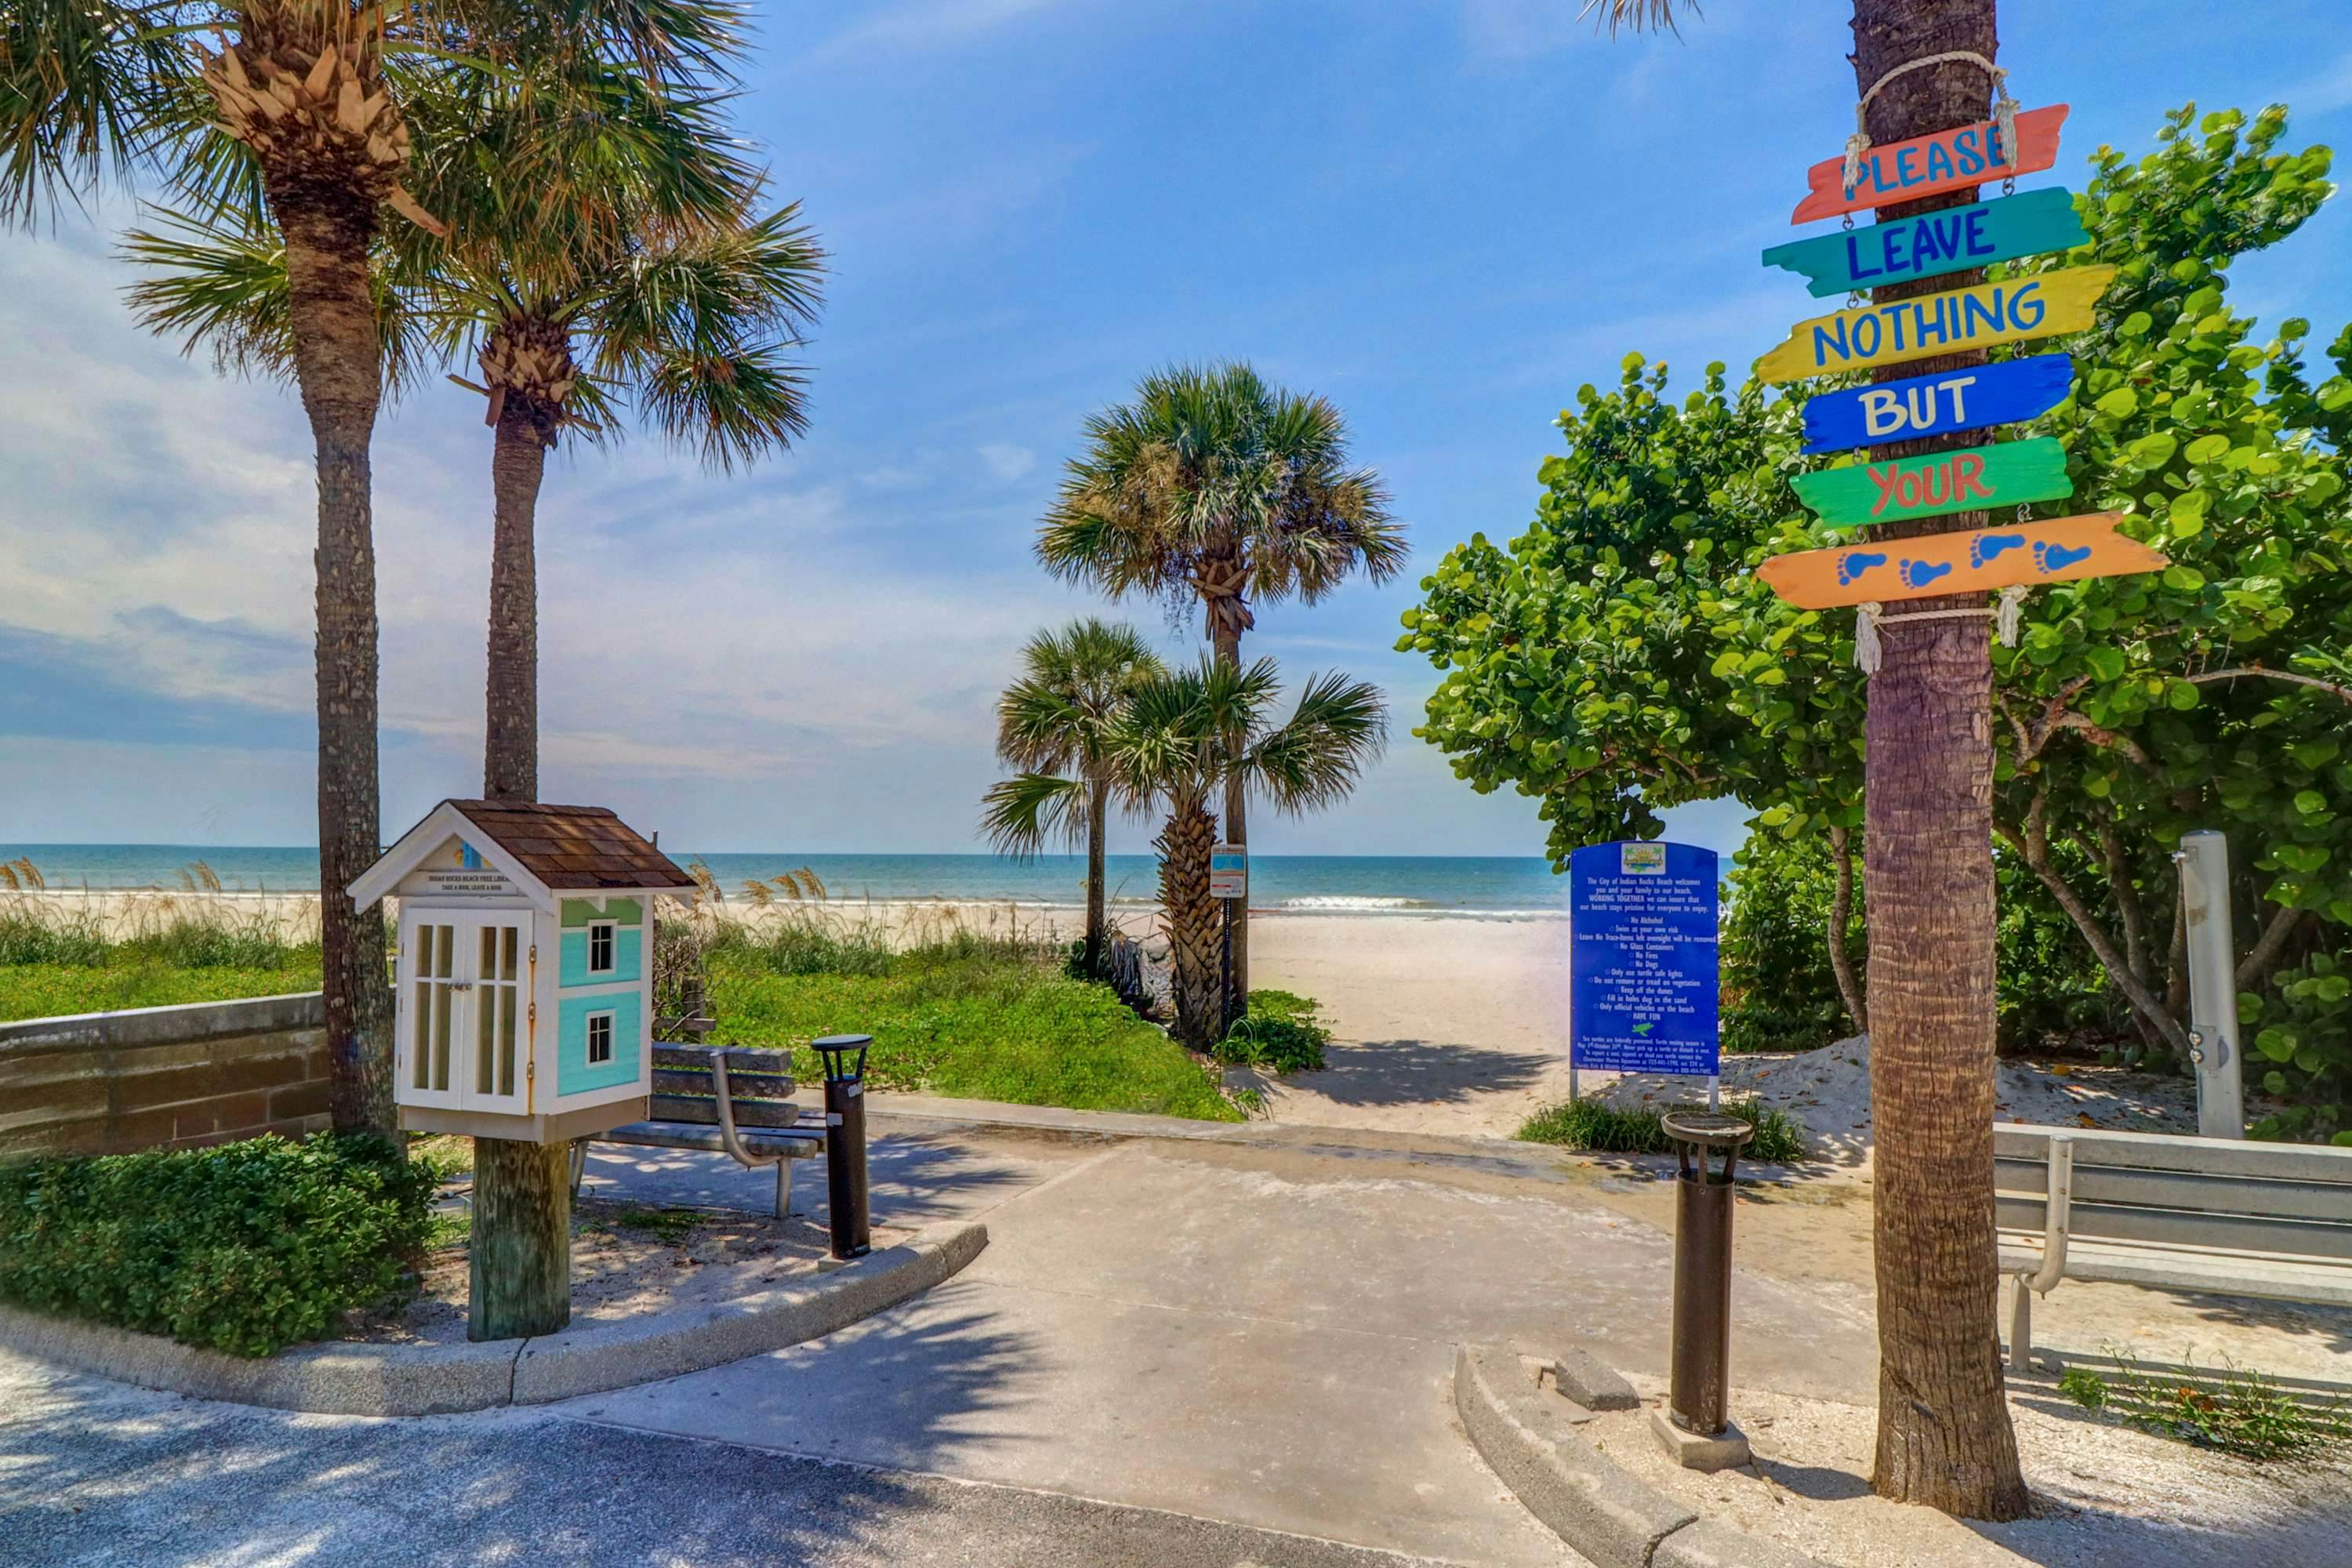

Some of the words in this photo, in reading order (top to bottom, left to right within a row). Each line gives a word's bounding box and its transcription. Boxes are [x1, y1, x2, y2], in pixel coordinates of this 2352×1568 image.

[1841, 125, 2005, 201] PLEASE
[1846, 209, 1994, 281] LEAVE
[1813, 282, 2045, 366] NOTHING
[1858, 376, 1976, 436] BUT
[1866, 454, 1994, 516] YOUR
[1599, 877, 1610, 886] City
[1621, 986, 1634, 995] Keep
[1668, 970, 1682, 978] lights
[1600, 1003, 1612, 1011] Only
